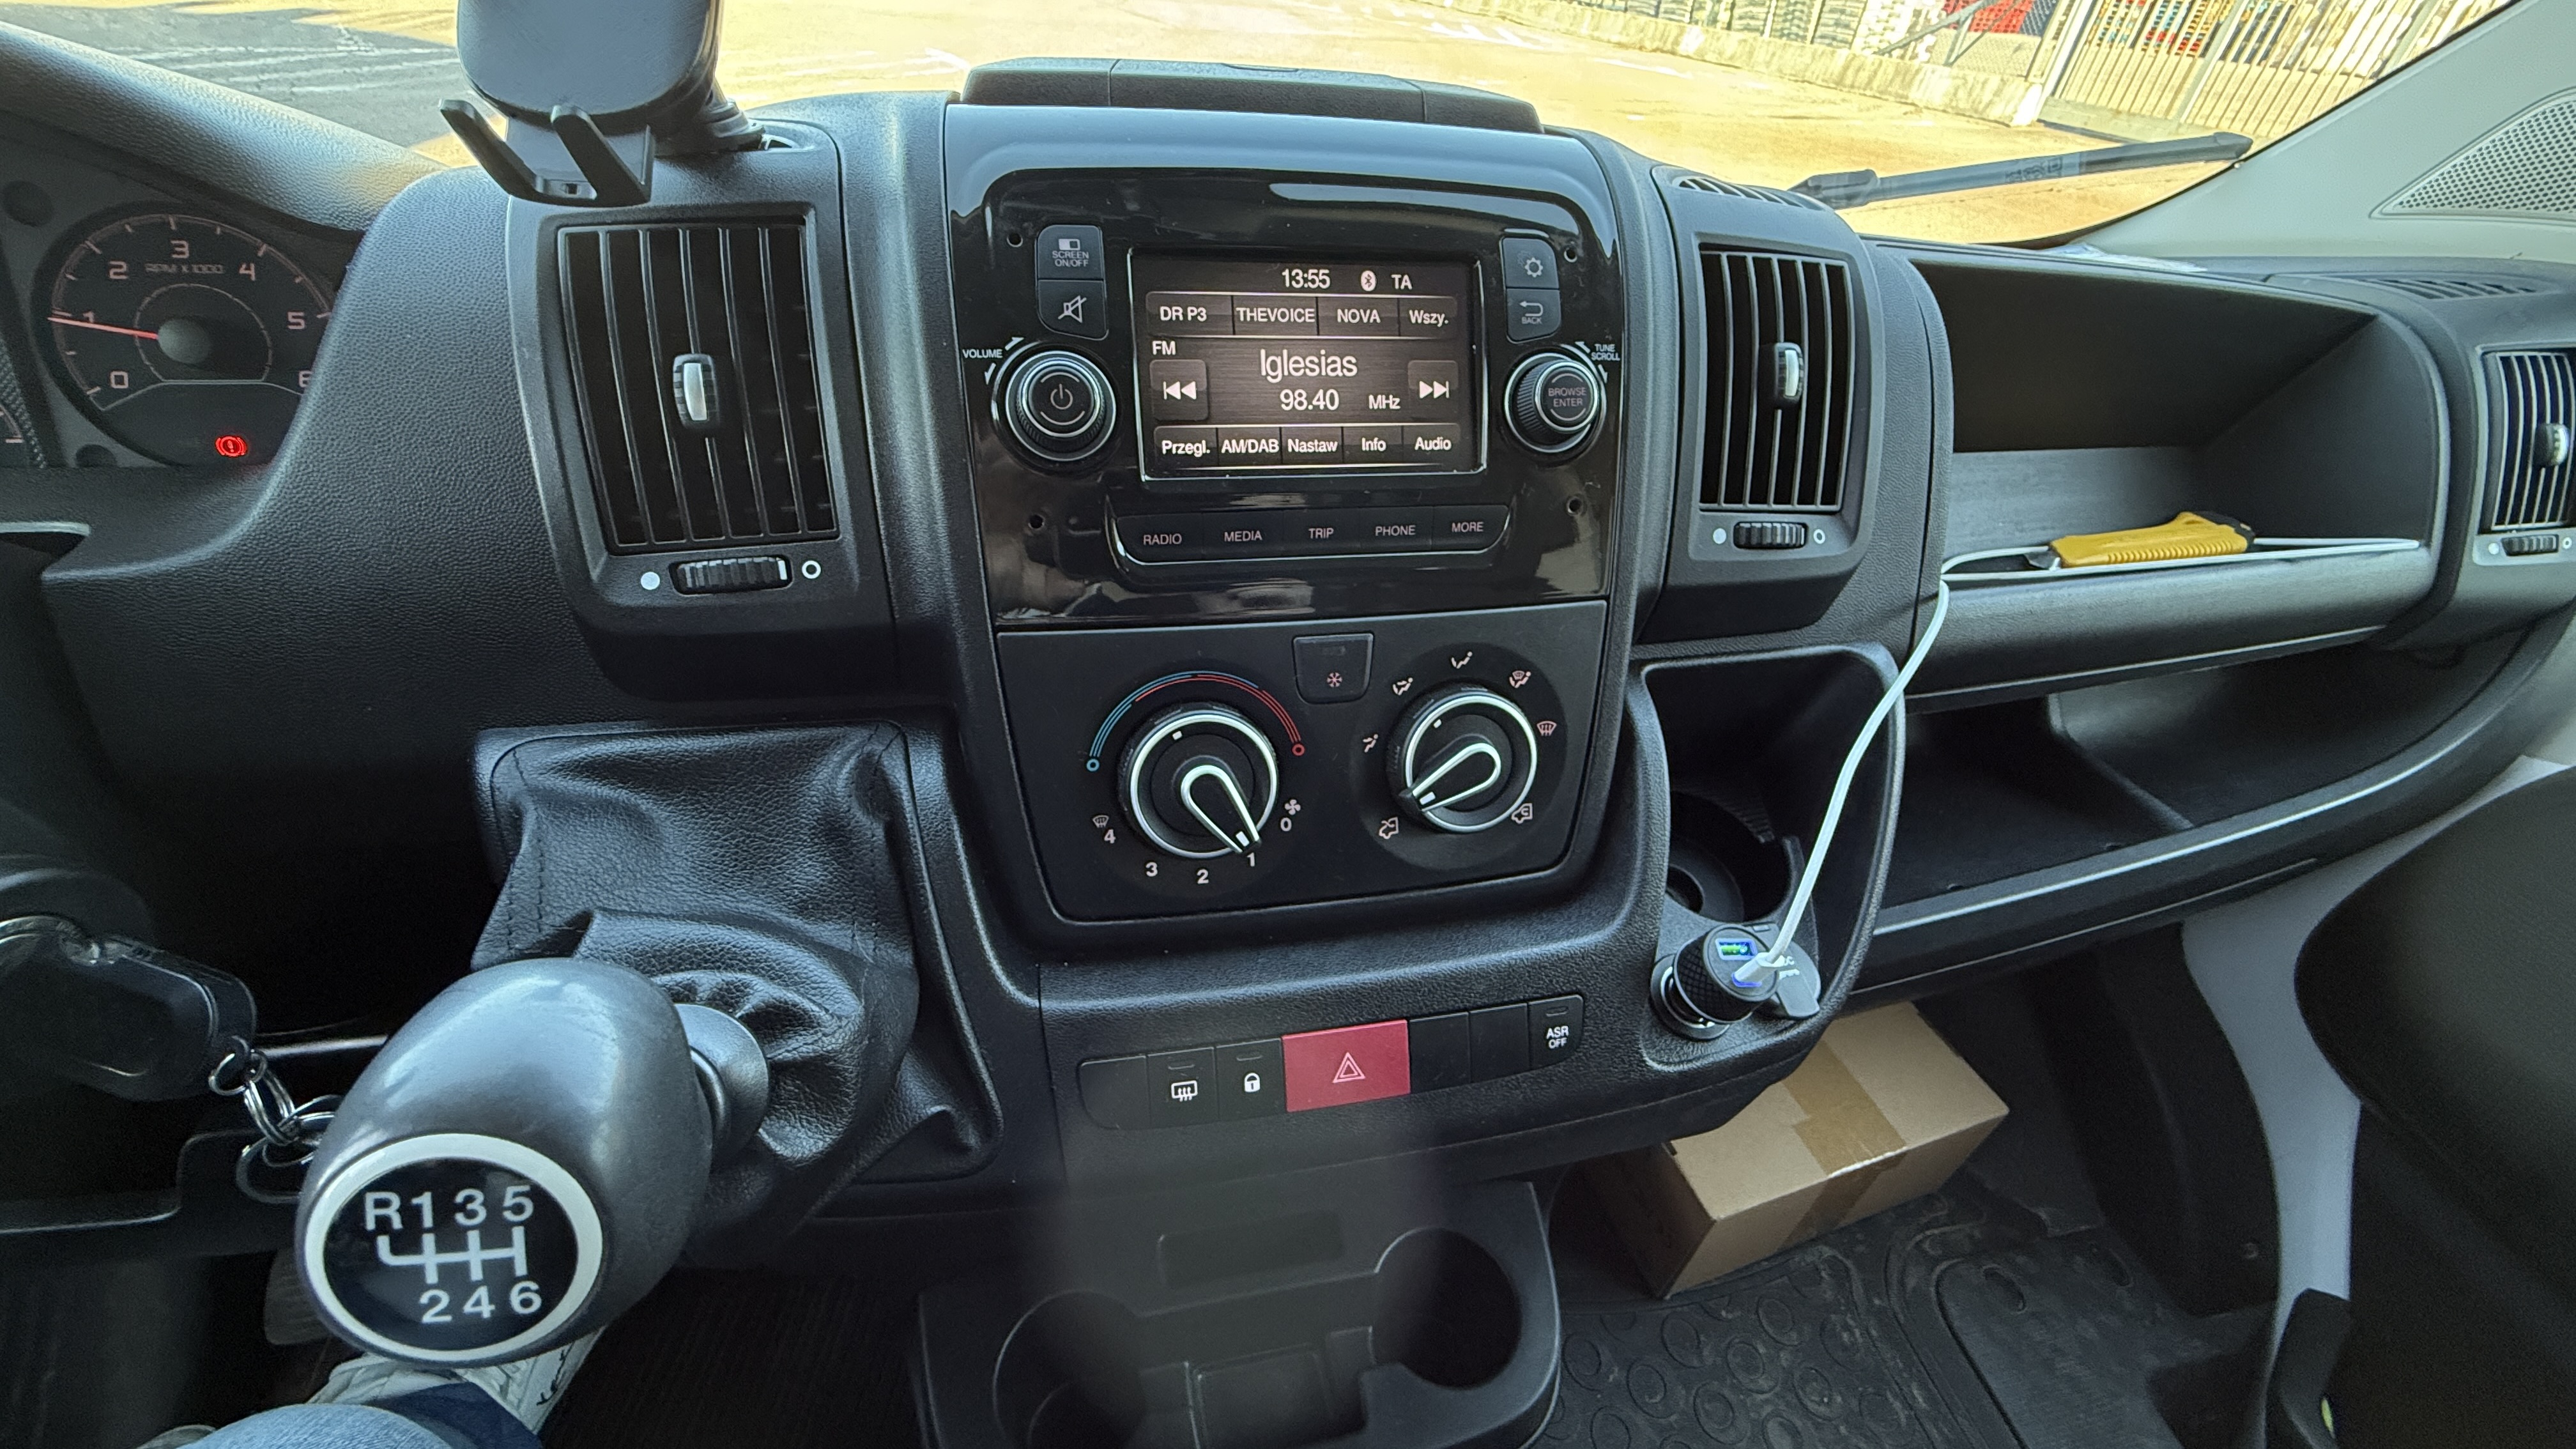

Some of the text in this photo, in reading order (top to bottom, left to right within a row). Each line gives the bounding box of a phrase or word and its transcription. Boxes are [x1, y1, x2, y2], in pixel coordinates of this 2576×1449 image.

[171, 240, 190, 259] 3
[1052, 250, 1089, 259] SCREEN
[109, 261, 128, 280] 2
[1054, 259, 1089, 267] ON/OFF
[239, 263, 256, 281] 4
[1282, 268, 1413, 290] 13:55 TA
[81, 311, 95, 324] 1
[288, 311, 305, 330] 5
[1160, 306, 1207, 322] DR P3
[1236, 307, 1315, 323] THEVOICE
[1337, 308, 1381, 323] NOVA
[1409, 309, 1448, 328] Wszy.
[1521, 316, 1543, 325] BACK
[962, 348, 1003, 358] VOLUME
[1152, 340, 1176, 355] FM
[1594, 343, 1616, 353] TUNE
[1591, 352, 1621, 362] SCROLL
[1260, 348, 1358, 383] Iglesias
[110, 371, 129, 389] 0
[1280, 388, 1400, 411] 98.40 MHz
[1548, 387, 1587, 397] BROWSE
[1553, 397, 1584, 408] ENTER
[1162, 440, 1211, 457] Przegl.
[1221, 438, 1280, 454] AM/DAB
[1287, 438, 1338, 453] Nastaw
[1361, 437, 1386, 452] Info
[1414, 436, 1452, 451] Audio
[1308, 527, 1334, 539] TRIP
[1375, 525, 1416, 537] PHONE
[1452, 521, 1483, 533] MORE
[1143, 533, 1183, 546] RADIO
[1224, 530, 1262, 542] MEDIA
[1280, 817, 1292, 832] 0
[1104, 829, 1116, 844] 4
[1247, 852, 1255, 867] 1
[1146, 862, 1158, 877] 3
[1197, 869, 1209, 884] 2
[1546, 1025, 1569, 1039] ASR
[1548, 1037, 1568, 1049] OFF
[364, 1184, 533, 1230] R 1 3 5
[419, 1280, 542, 1324] 2 4 6
